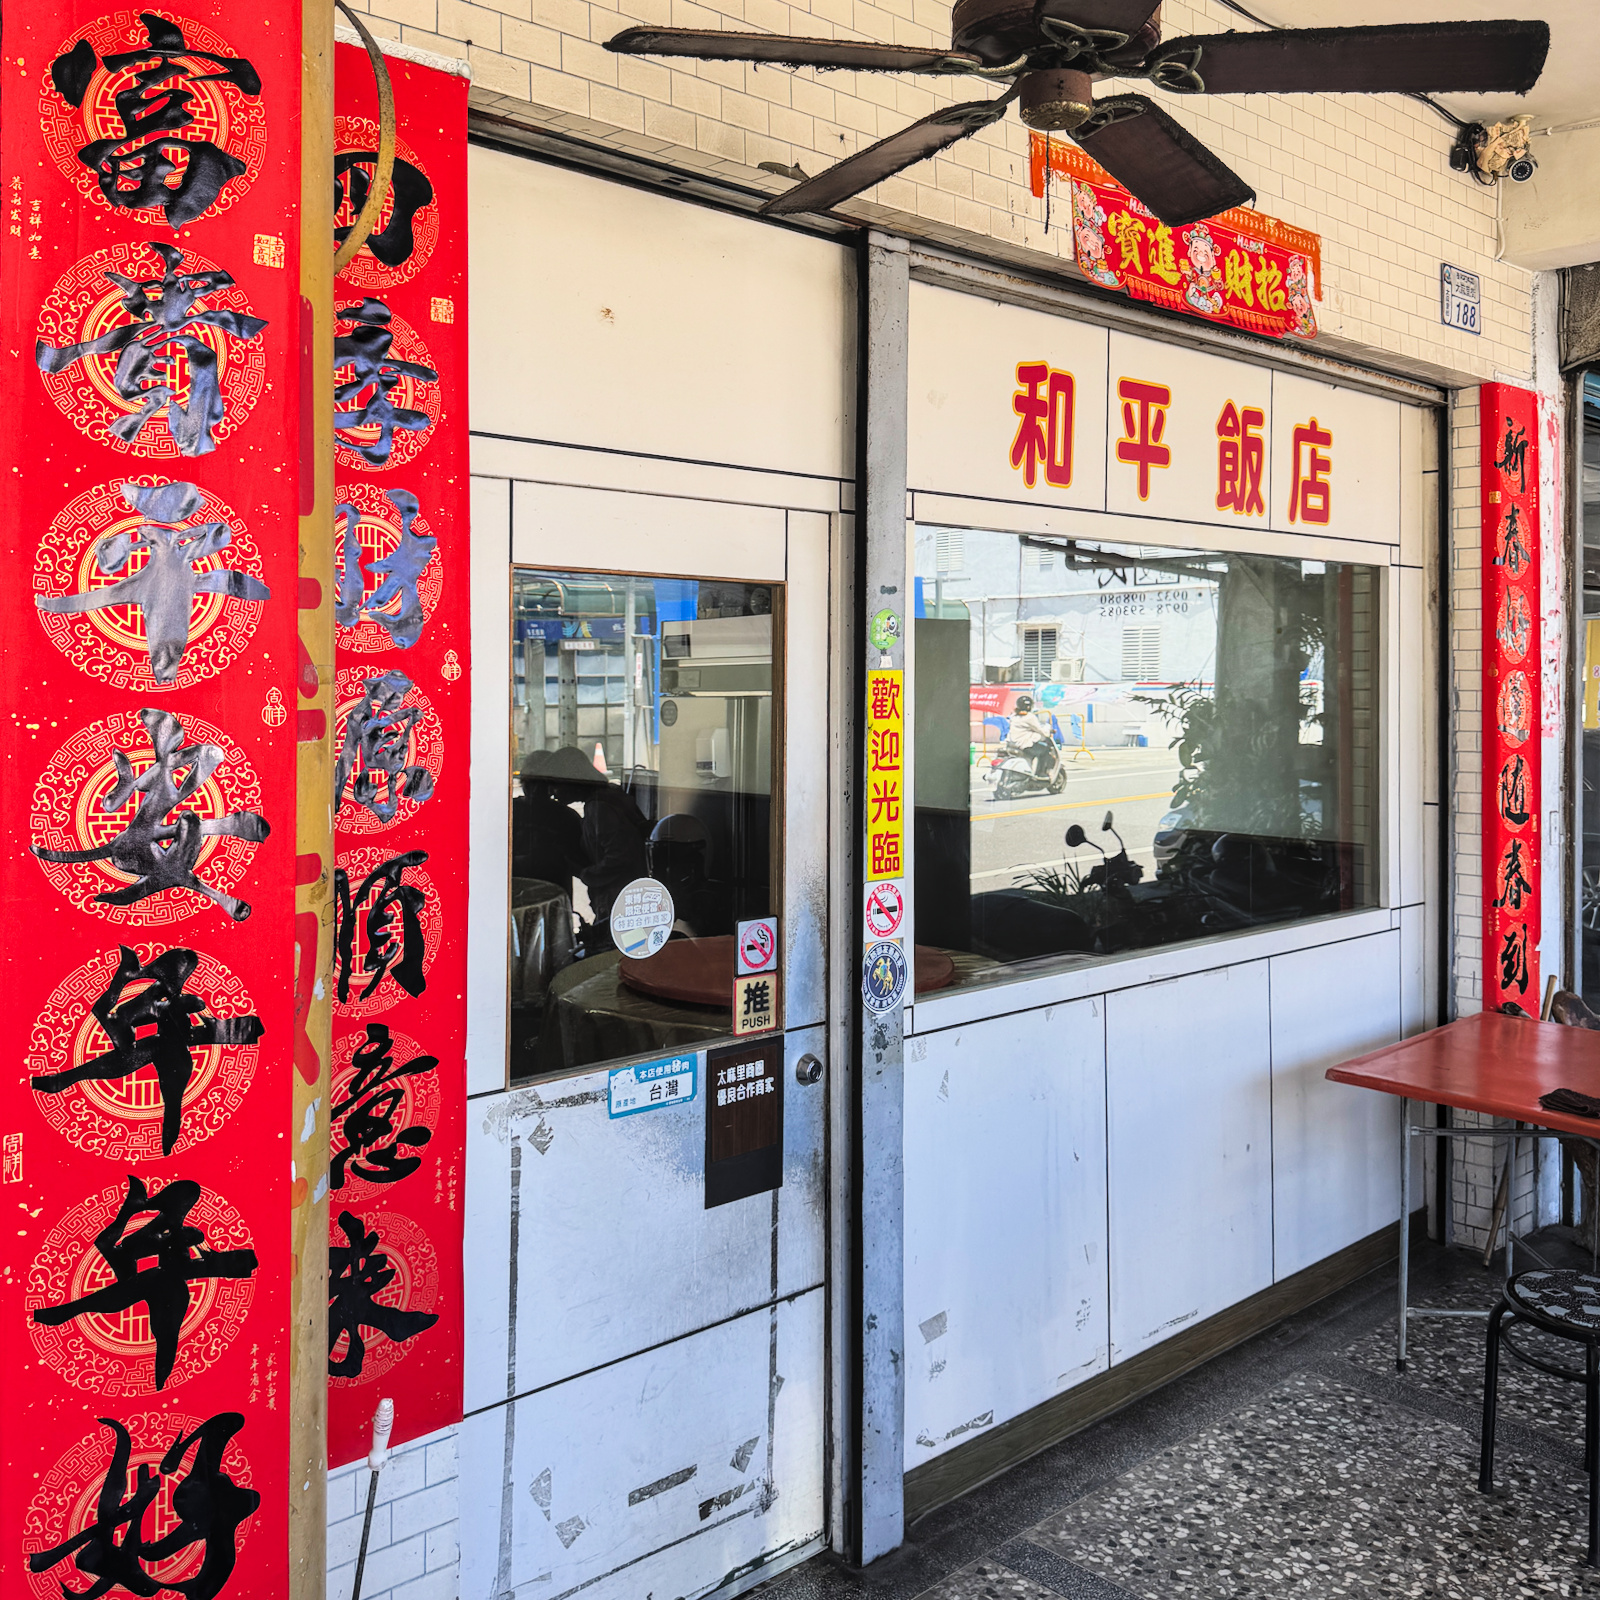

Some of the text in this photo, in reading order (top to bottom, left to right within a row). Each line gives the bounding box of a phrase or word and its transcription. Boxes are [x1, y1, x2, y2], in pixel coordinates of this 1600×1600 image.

[1456, 302, 1475, 327] 188
[1010, 360, 1333, 526] 和平飯店
[871, 677, 901, 876] 歡迎光臨
[743, 980, 770, 1015] 推
[741, 1014, 771, 1030] PUSH
[639, 1059, 690, 1079] 本店使用豬肉
[649, 1079, 679, 1102] 台灣
